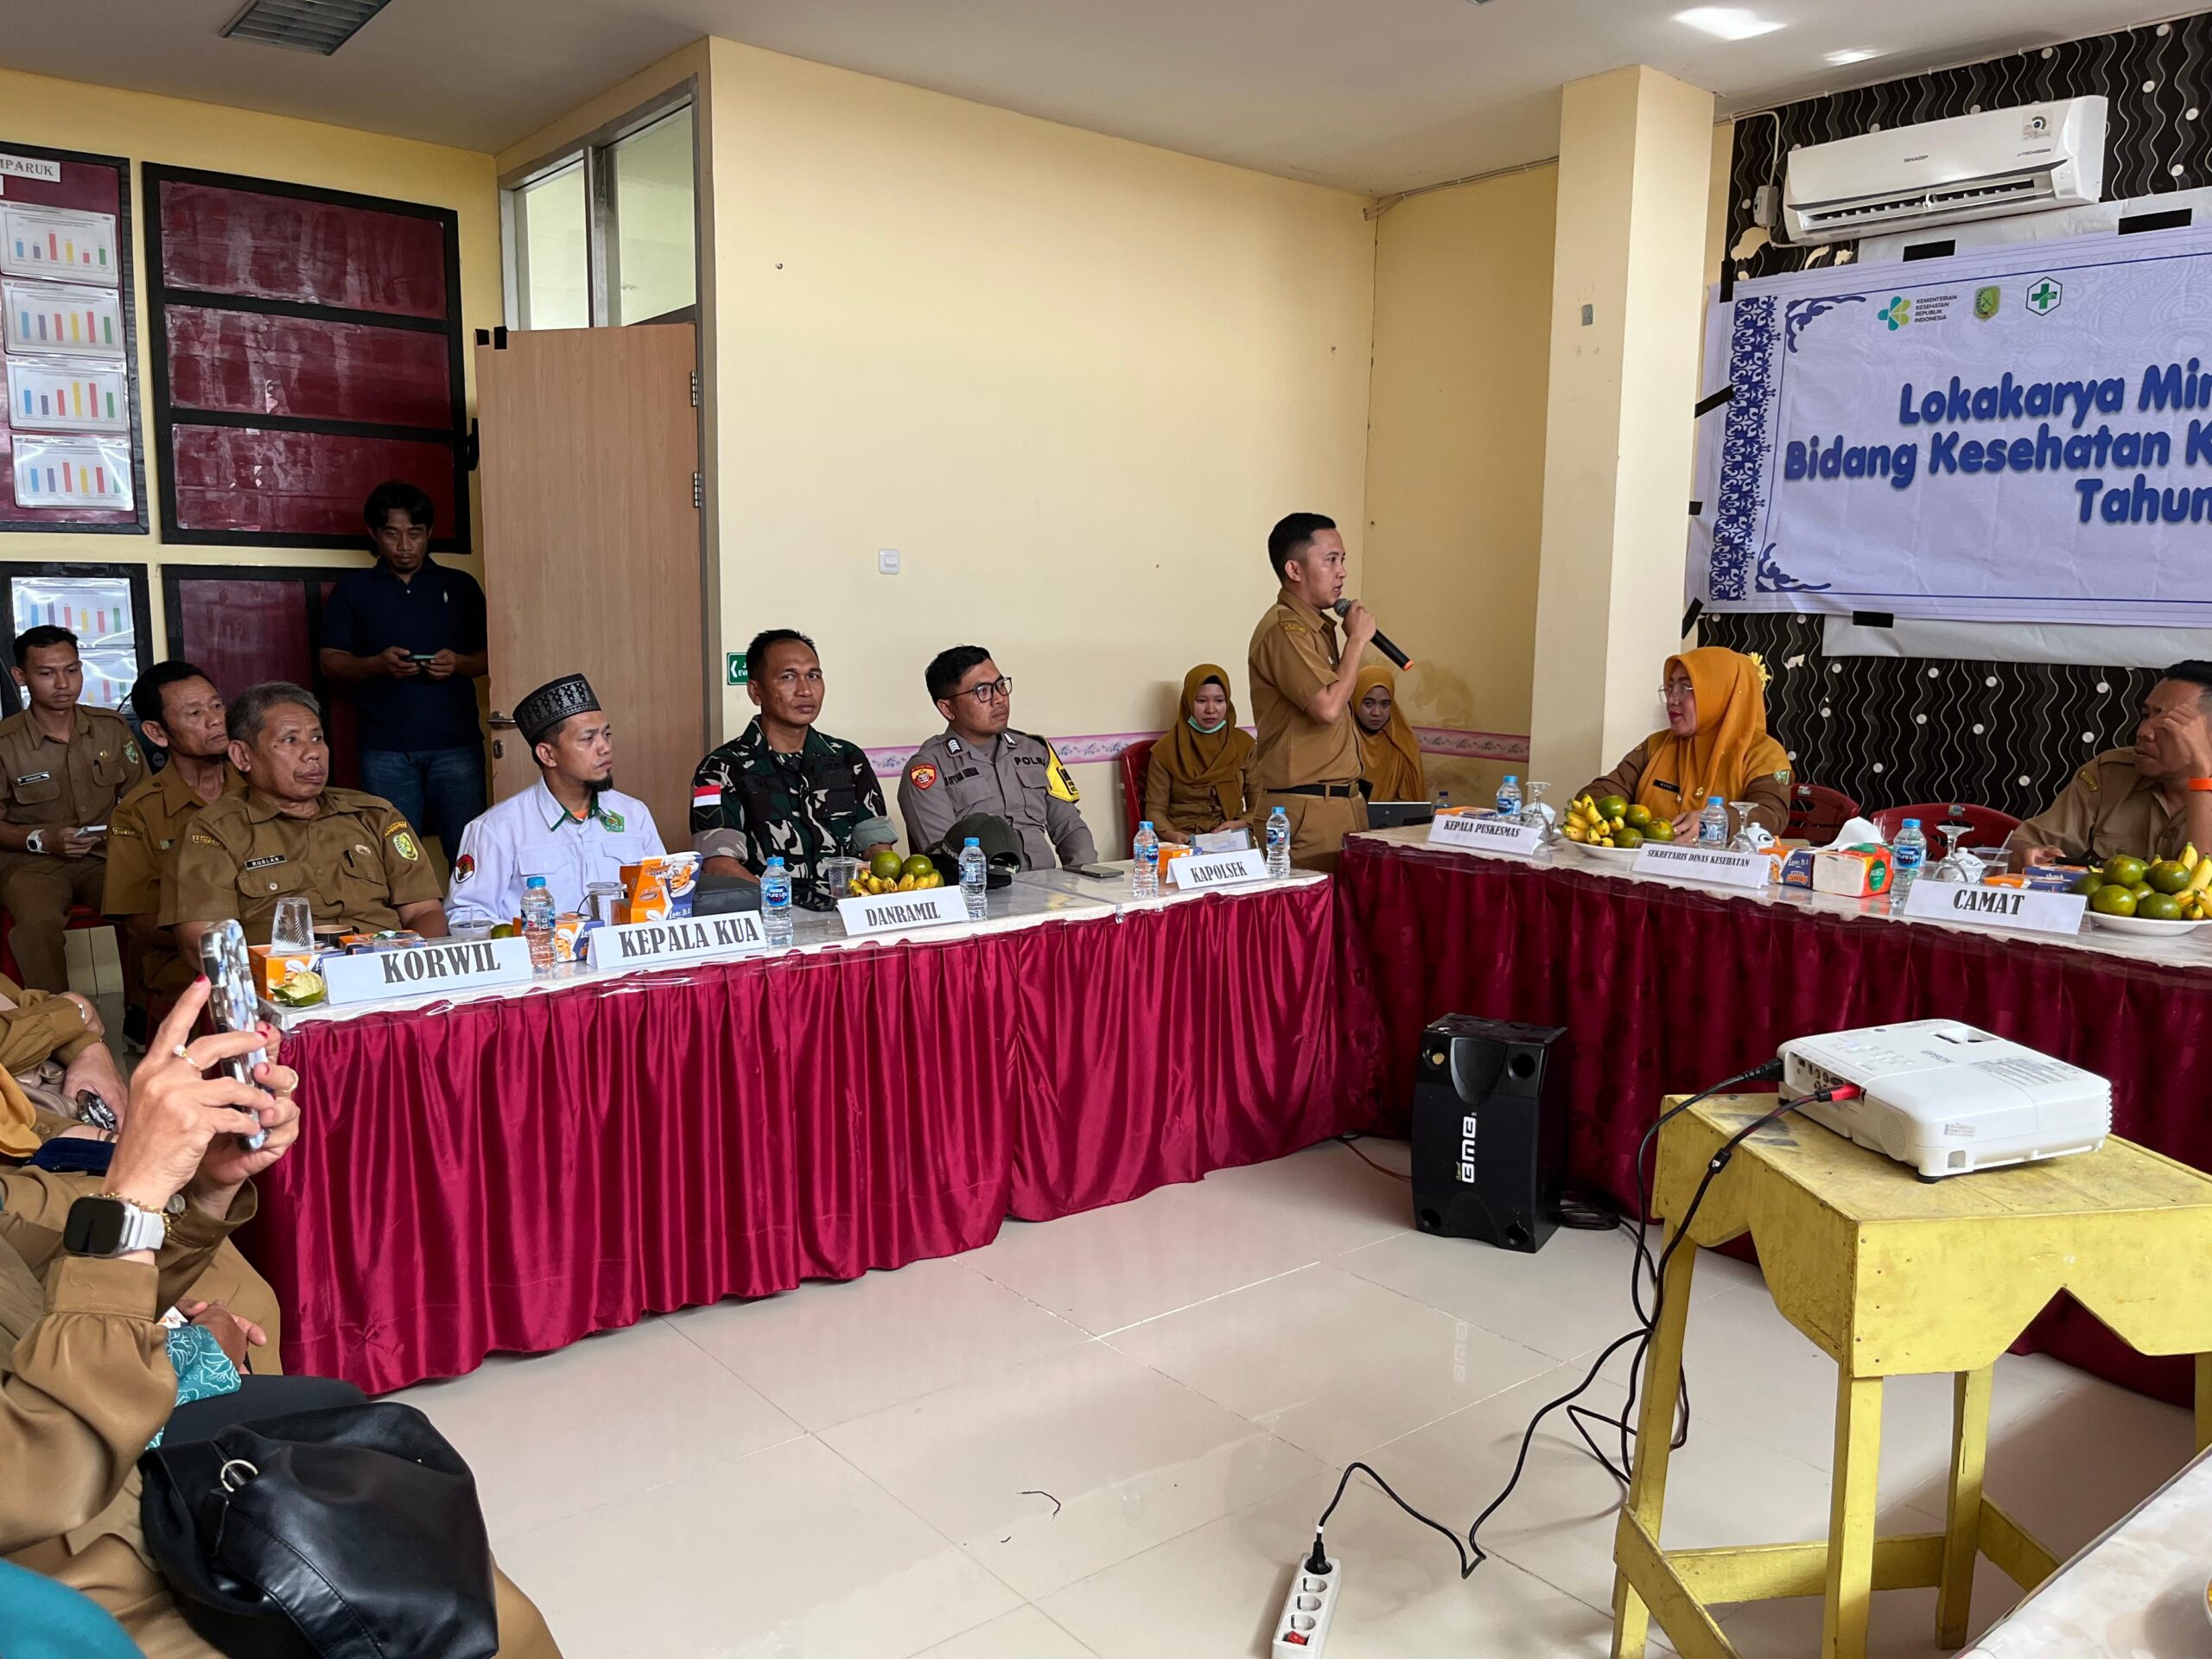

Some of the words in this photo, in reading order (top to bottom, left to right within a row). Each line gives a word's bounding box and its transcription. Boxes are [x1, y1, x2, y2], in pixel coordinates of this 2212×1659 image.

[1916, 295, 1957, 303] KEMENTERIAN
[1900, 372, 2125, 429] Lokakarya
[1784, 435, 1917, 489] Bidang
[1929, 423, 2171, 474] Kesehatan
[2075, 474, 2212, 524] Tahun
[1444, 820, 1474, 833] KEPALA
[1475, 823, 1521, 837] PUSKESMAS
[1190, 861, 1248, 883] KAPOLSEK
[1647, 849, 1688, 861] SEKRETARIS
[1688, 854, 1710, 862] DINAS
[1710, 855, 1751, 868] KESEHATAN
[865, 901, 941, 927] DANRAMIL
[1953, 888, 2025, 916] CAMAT
[618, 923, 710, 958] KEPALA
[713, 917, 760, 945] KUA
[380, 942, 501, 984] KORWIL
